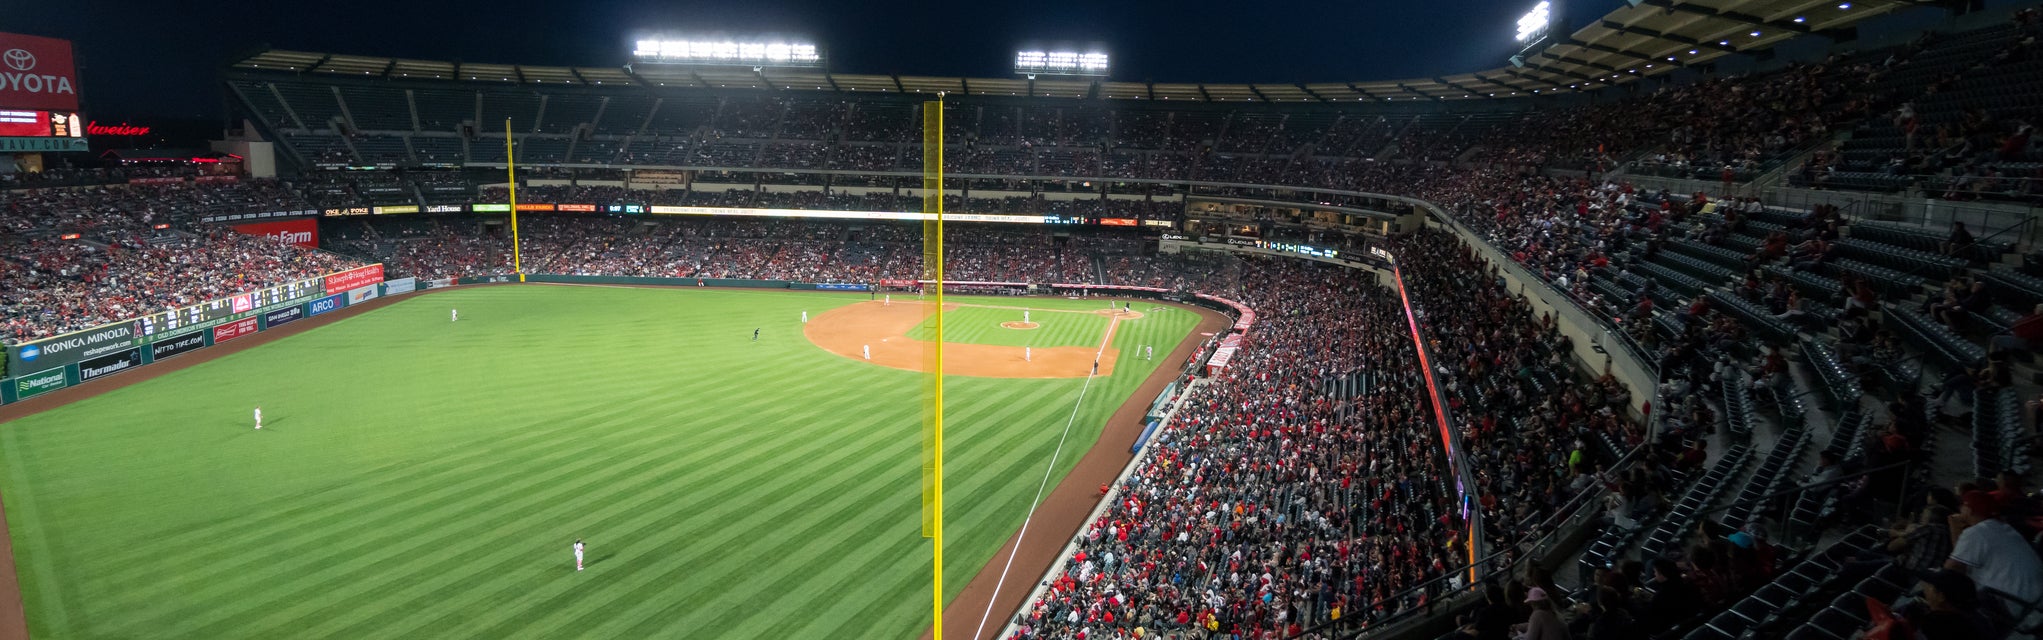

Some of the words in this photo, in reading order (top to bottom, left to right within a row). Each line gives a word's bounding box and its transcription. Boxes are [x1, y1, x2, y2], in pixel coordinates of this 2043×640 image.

[312, 300, 334, 314] ARCO
[43, 337, 86, 355] KONICA
[87, 327, 130, 345] MINOLTA
[83, 340, 132, 357] reshapework.com
[154, 343, 174, 355] NITTO
[175, 335, 203, 348] TIRE.COM
[82, 359, 131, 379] Thermador
[29, 372, 63, 388] National
